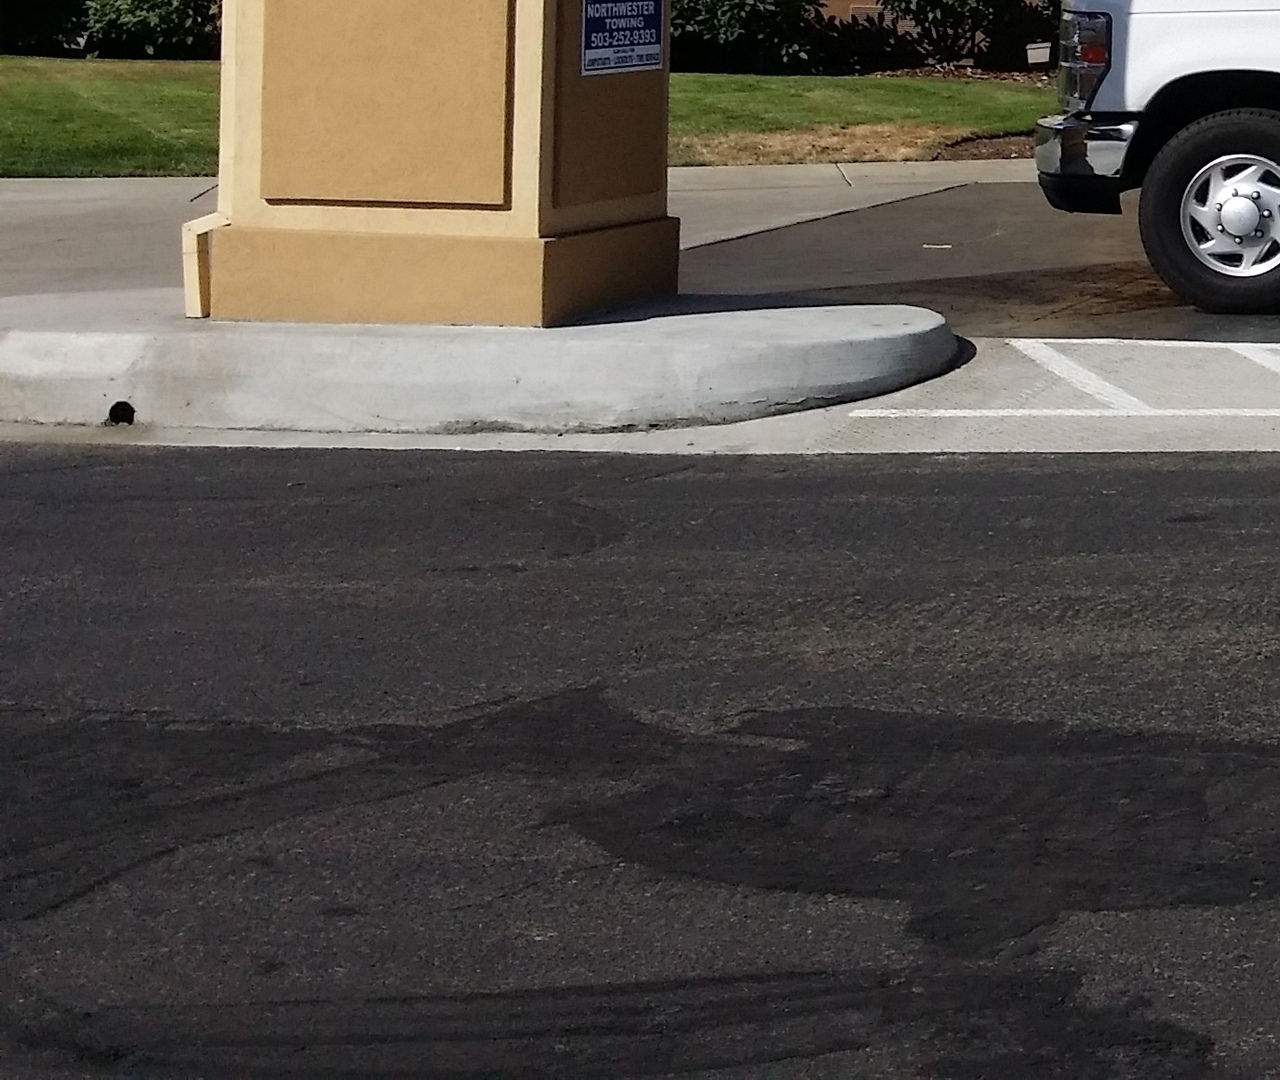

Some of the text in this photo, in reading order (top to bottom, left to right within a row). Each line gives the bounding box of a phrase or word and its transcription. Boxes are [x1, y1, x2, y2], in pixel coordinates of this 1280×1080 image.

[587, 1, 655, 18] NORTHWESTER
[605, 17, 645, 29] TOWING
[591, 29, 656, 47] 503-252-9393
